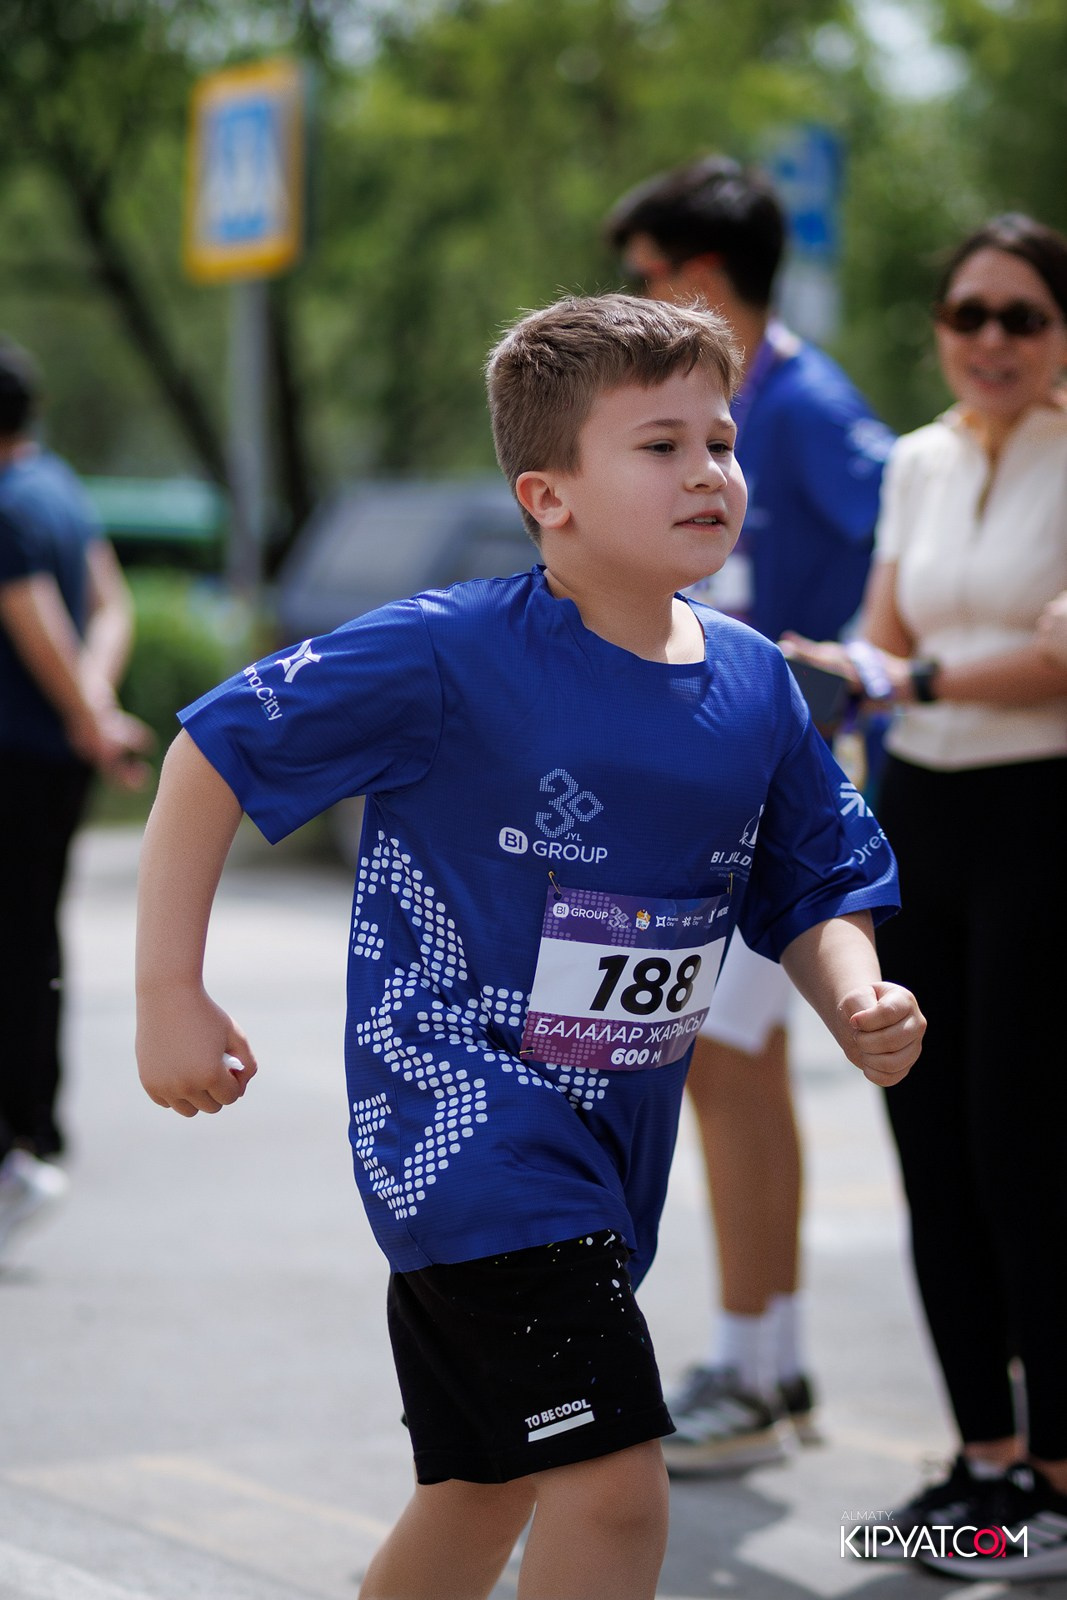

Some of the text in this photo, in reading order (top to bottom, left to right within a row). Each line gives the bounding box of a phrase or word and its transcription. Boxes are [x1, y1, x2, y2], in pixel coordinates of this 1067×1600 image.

[502, 829, 608, 864] BI GROUP
[564, 832, 582, 842] JYL
[711, 851, 725, 863] BI
[571, 907, 609, 920] GROUP
[589, 954, 702, 1016] 188
[533, 1013, 705, 1044] БАЛАЛАР ЖАРЫСЫ
[611, 1048, 650, 1065] 600
[524, 1399, 592, 1429] TO BE COOL
